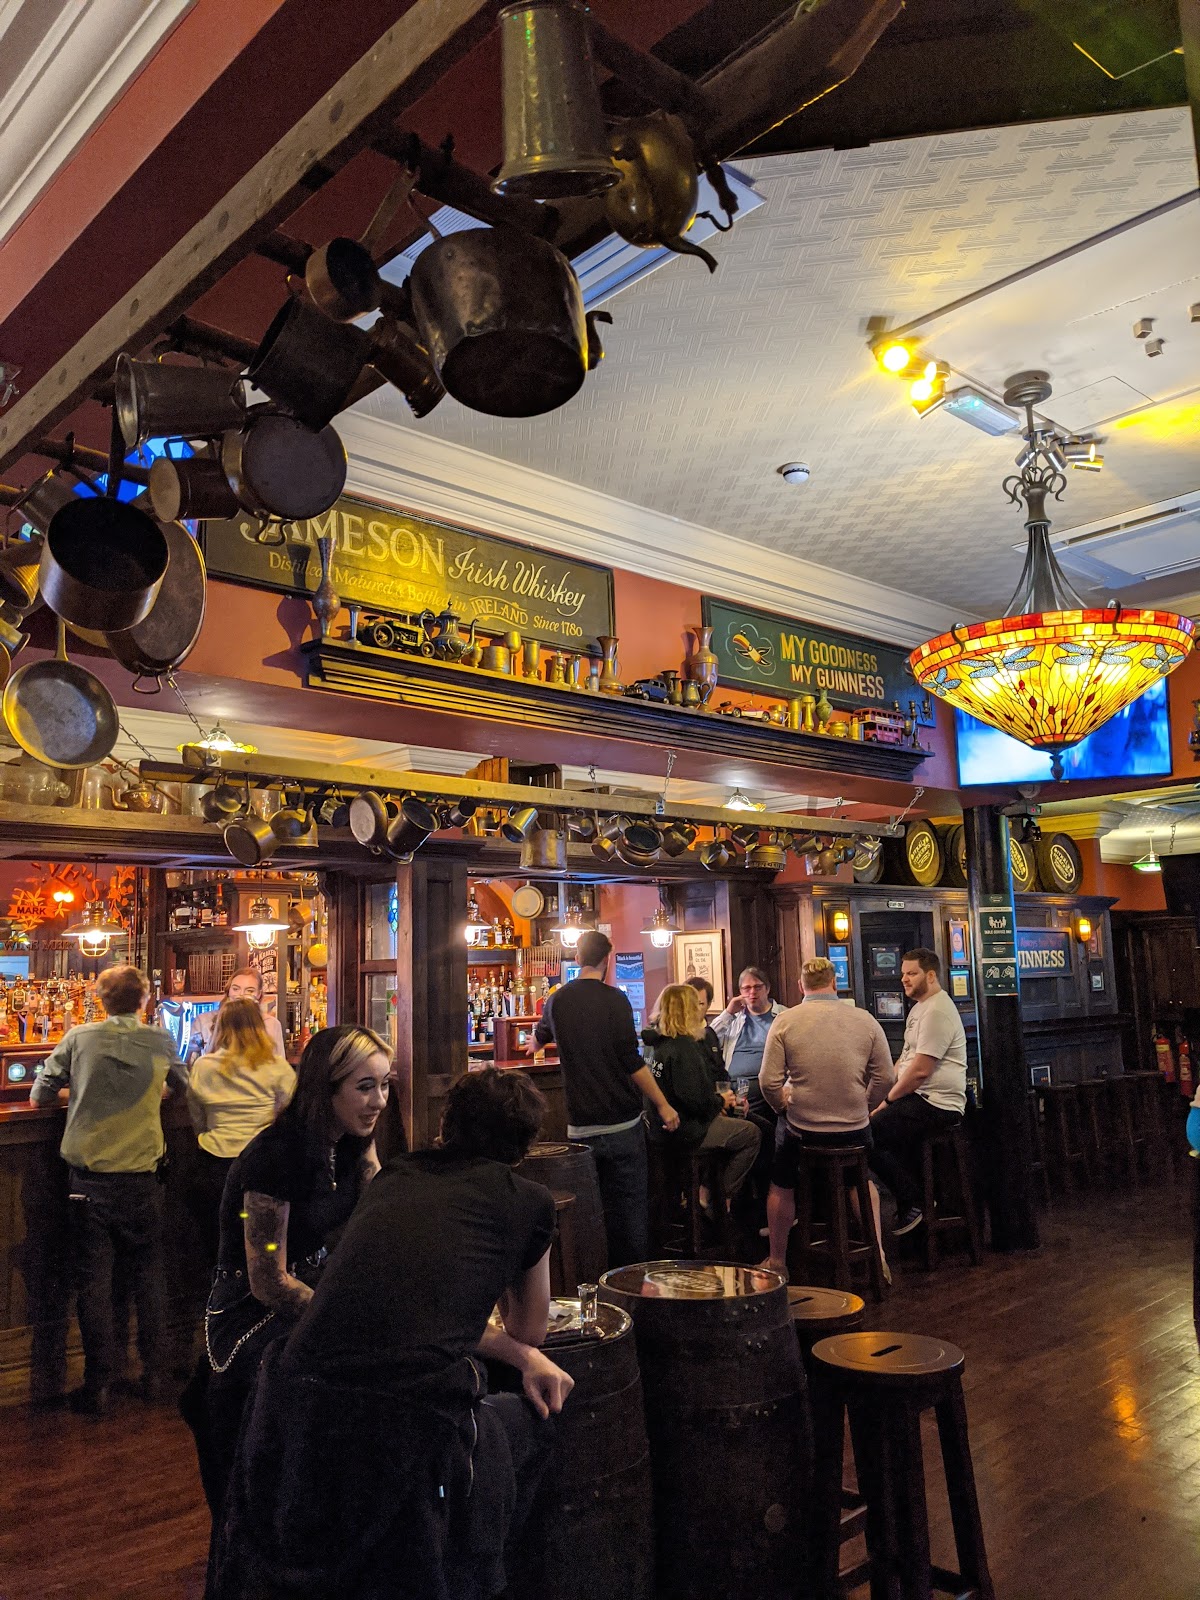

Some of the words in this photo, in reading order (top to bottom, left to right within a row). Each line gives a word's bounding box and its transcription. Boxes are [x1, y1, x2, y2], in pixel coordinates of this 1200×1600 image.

[240, 509, 444, 577] JAMESON
[448, 547, 509, 591] Irish
[512, 560, 585, 617] Whiskey
[407, 584, 451, 608] Bottled
[452, 596, 468, 612] in
[471, 598, 529, 625] IRELAND
[533, 615, 559, 631] Since
[561, 620, 583, 637] 1780
[780, 632, 806, 662] MY
[809, 639, 878, 673] GOODNESS
[791, 663, 813, 685] MY
[816, 667, 885, 700] GUINNESS
[16, 906, 47, 915] MARK
[1018, 950, 1065, 968] INNESS
